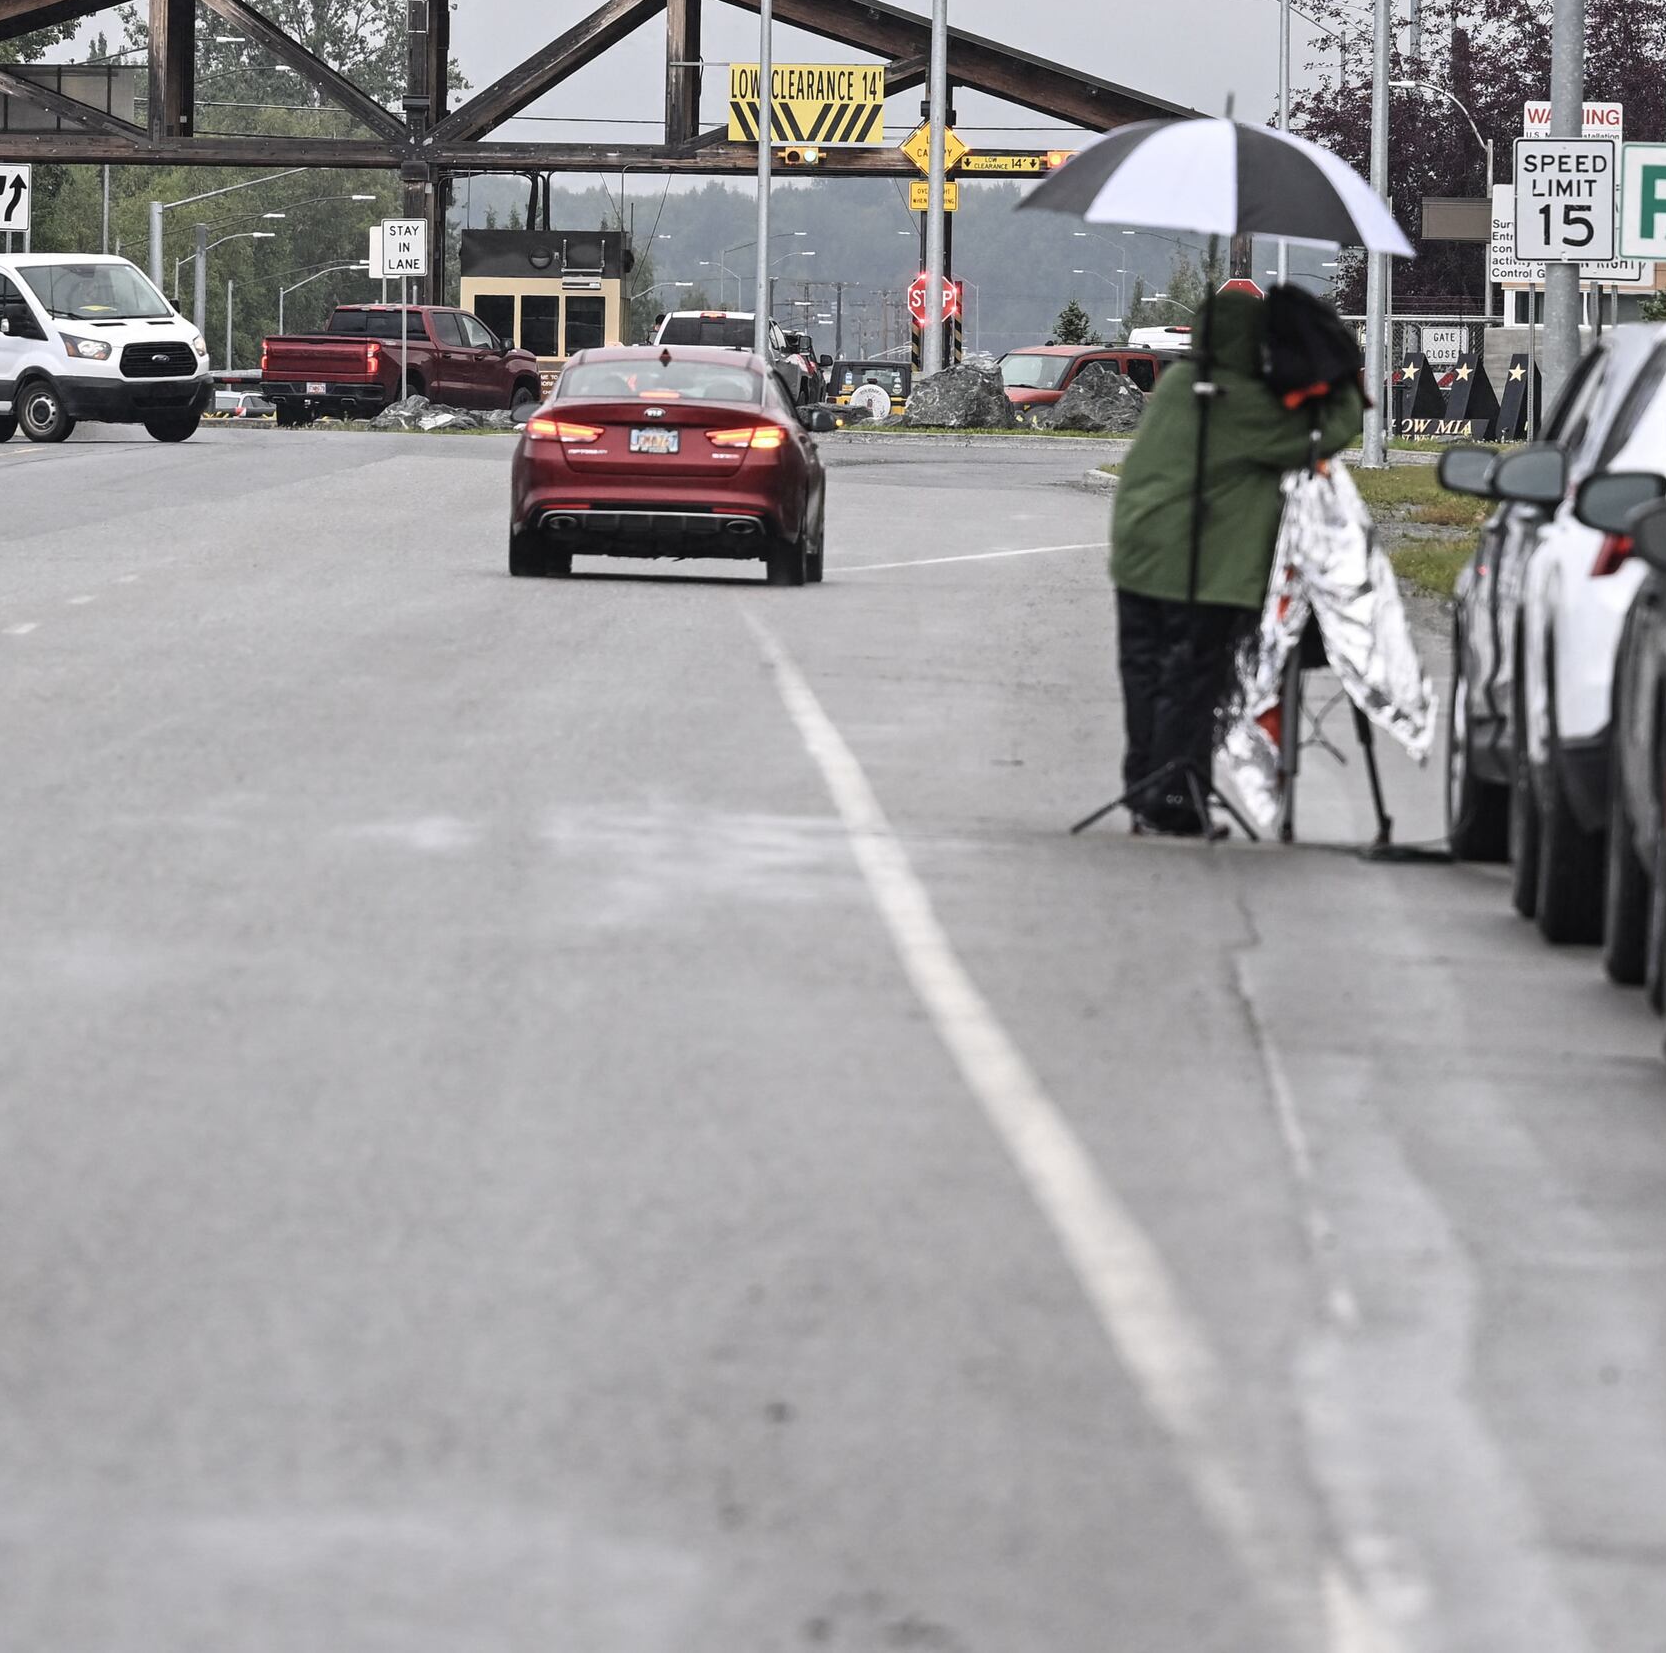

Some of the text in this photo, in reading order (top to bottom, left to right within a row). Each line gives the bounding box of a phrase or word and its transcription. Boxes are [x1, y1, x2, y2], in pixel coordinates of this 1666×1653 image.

[731, 69, 882, 101] LOW CLEARANCE 14'
[1527, 108, 1620, 125] WING
[1523, 154, 1608, 173] SPEED
[1532, 179, 1598, 198] LIMIT
[389, 225, 420, 237] STAY
[1539, 203, 1595, 247] 15
[399, 242, 410, 253] IN
[388, 259, 421, 270] LANE
[1492, 268, 1532, 278] Control
[911, 289, 953, 307] STP
[1433, 332, 1456, 342] GATE
[1426, 349, 1457, 359] CLOSE
[1392, 418, 1472, 435] OW MIA
